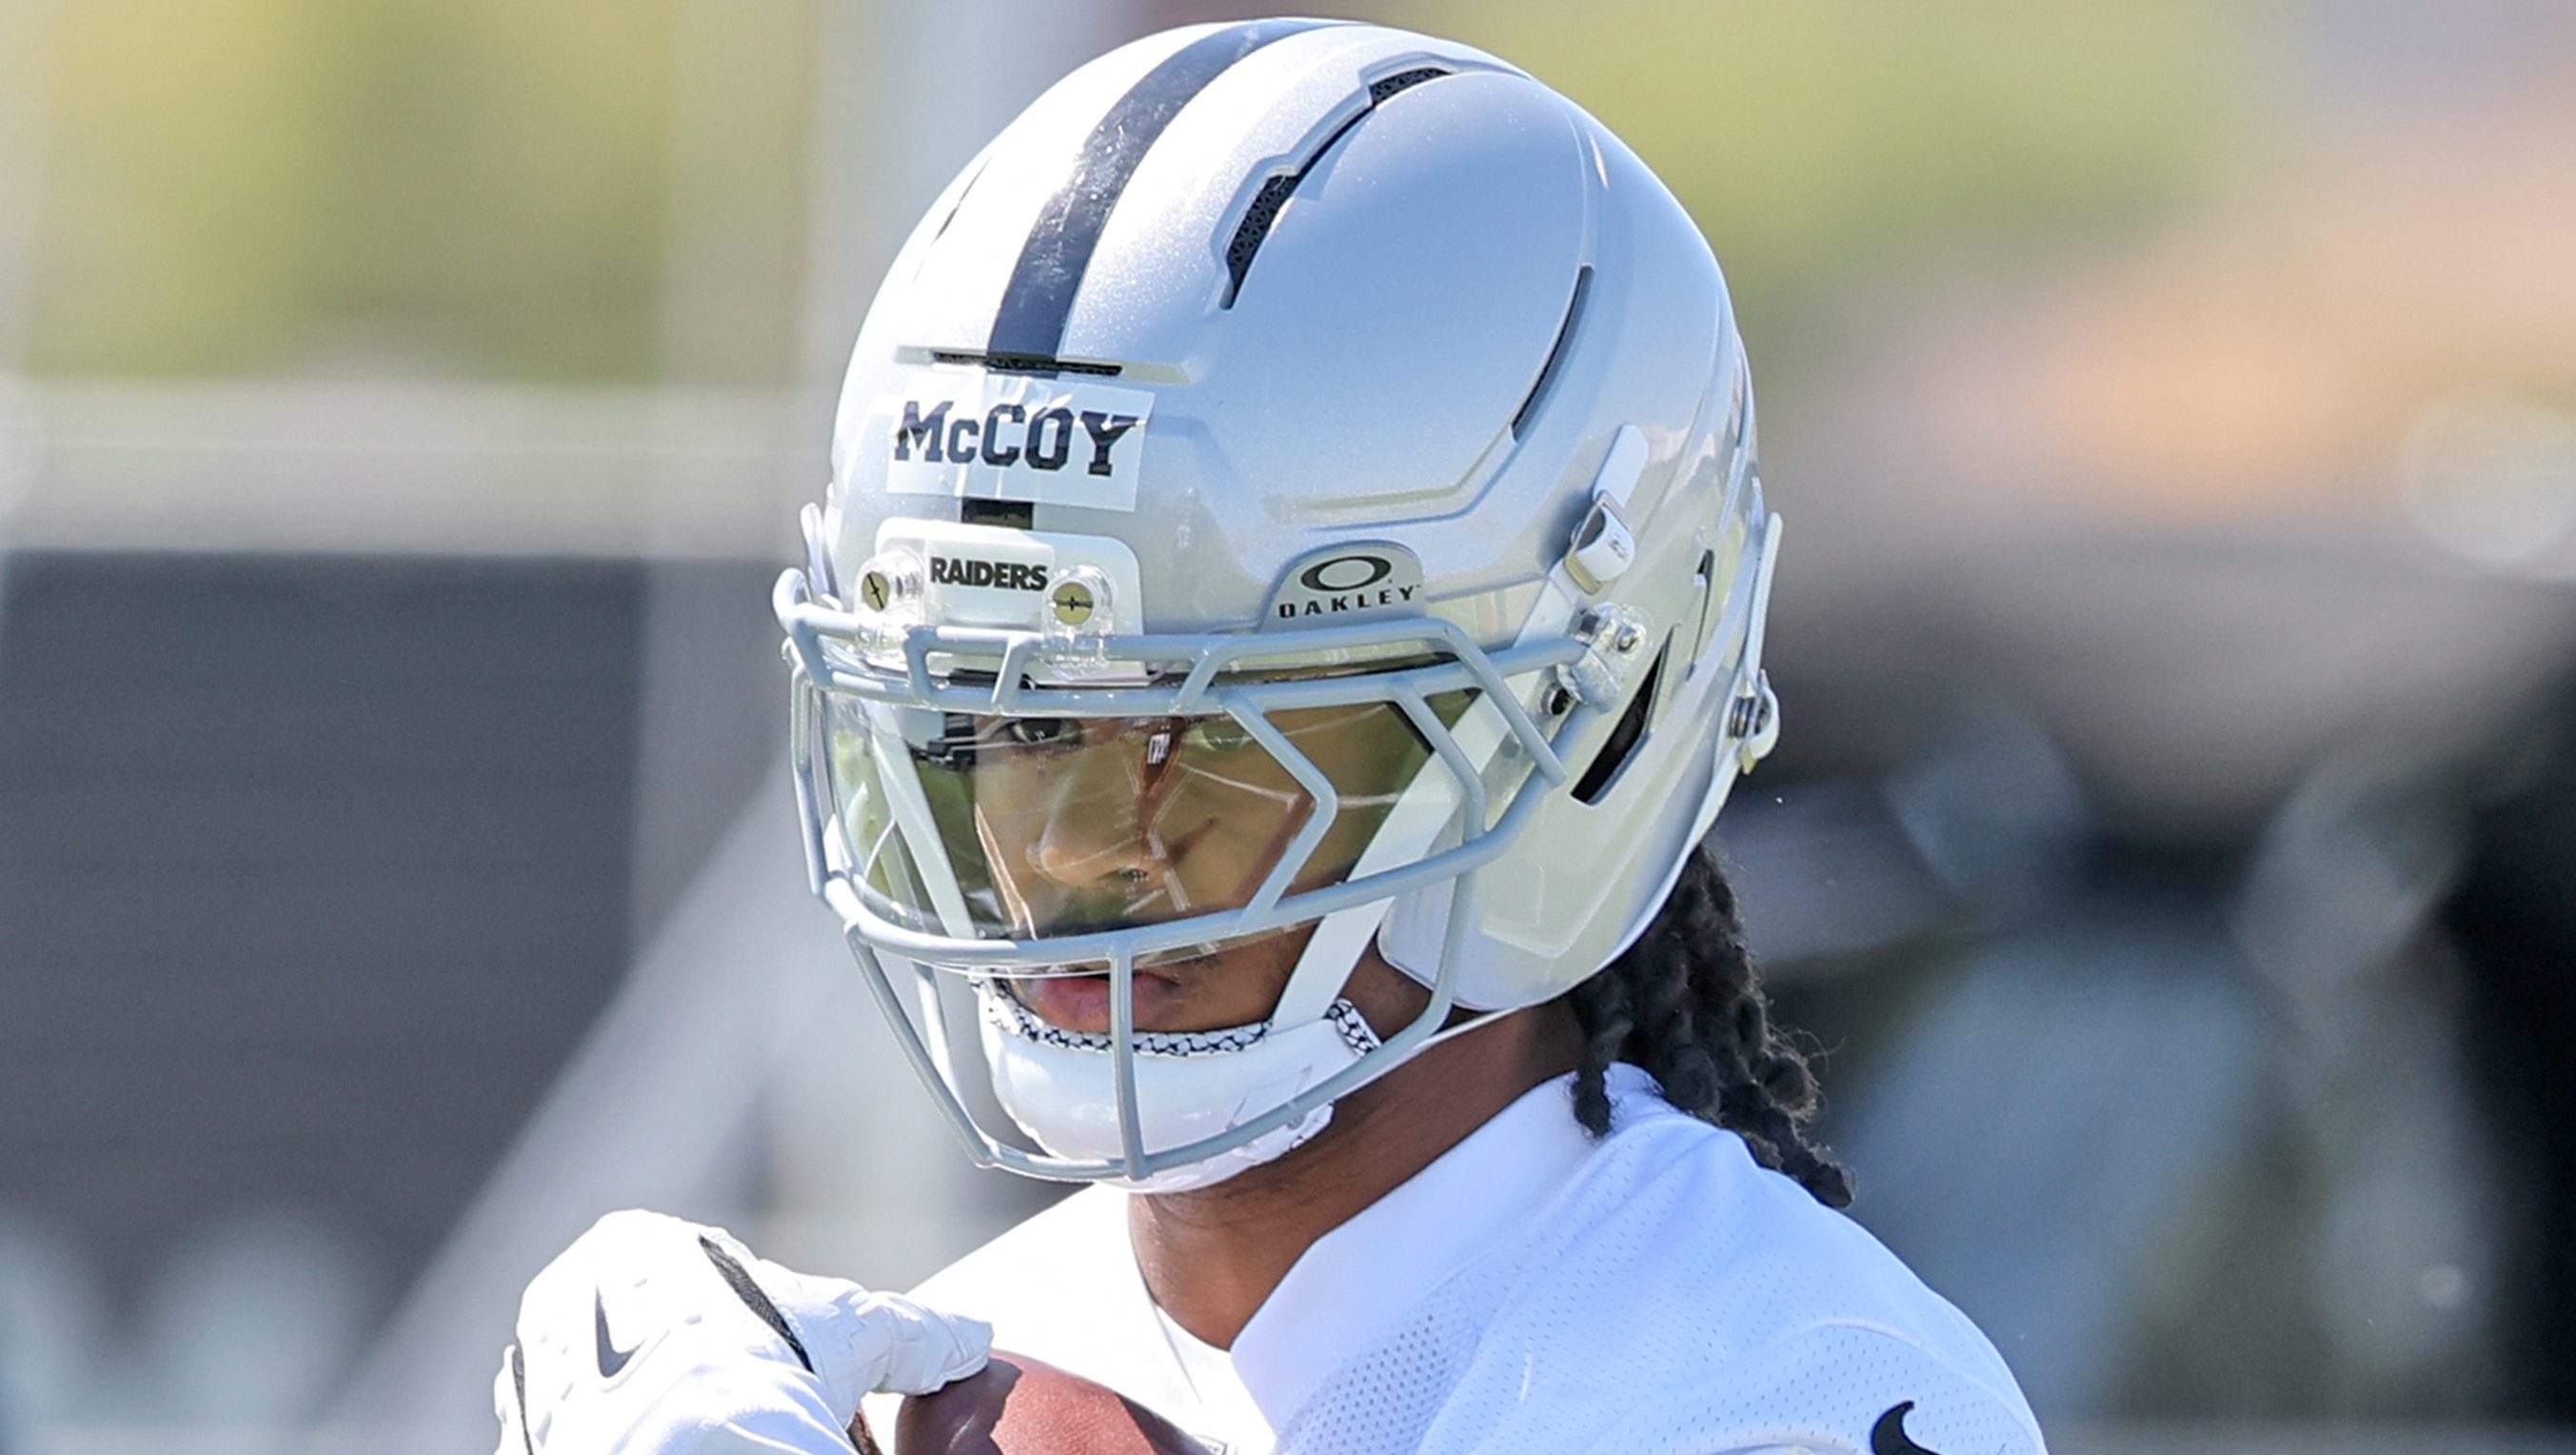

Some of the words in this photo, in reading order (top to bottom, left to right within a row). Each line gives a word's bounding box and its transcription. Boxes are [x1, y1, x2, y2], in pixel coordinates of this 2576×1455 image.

[894, 400, 1139, 477] McCOY
[929, 556, 1048, 592] RAIDERS
[1278, 585, 1416, 619] OAKLEY
